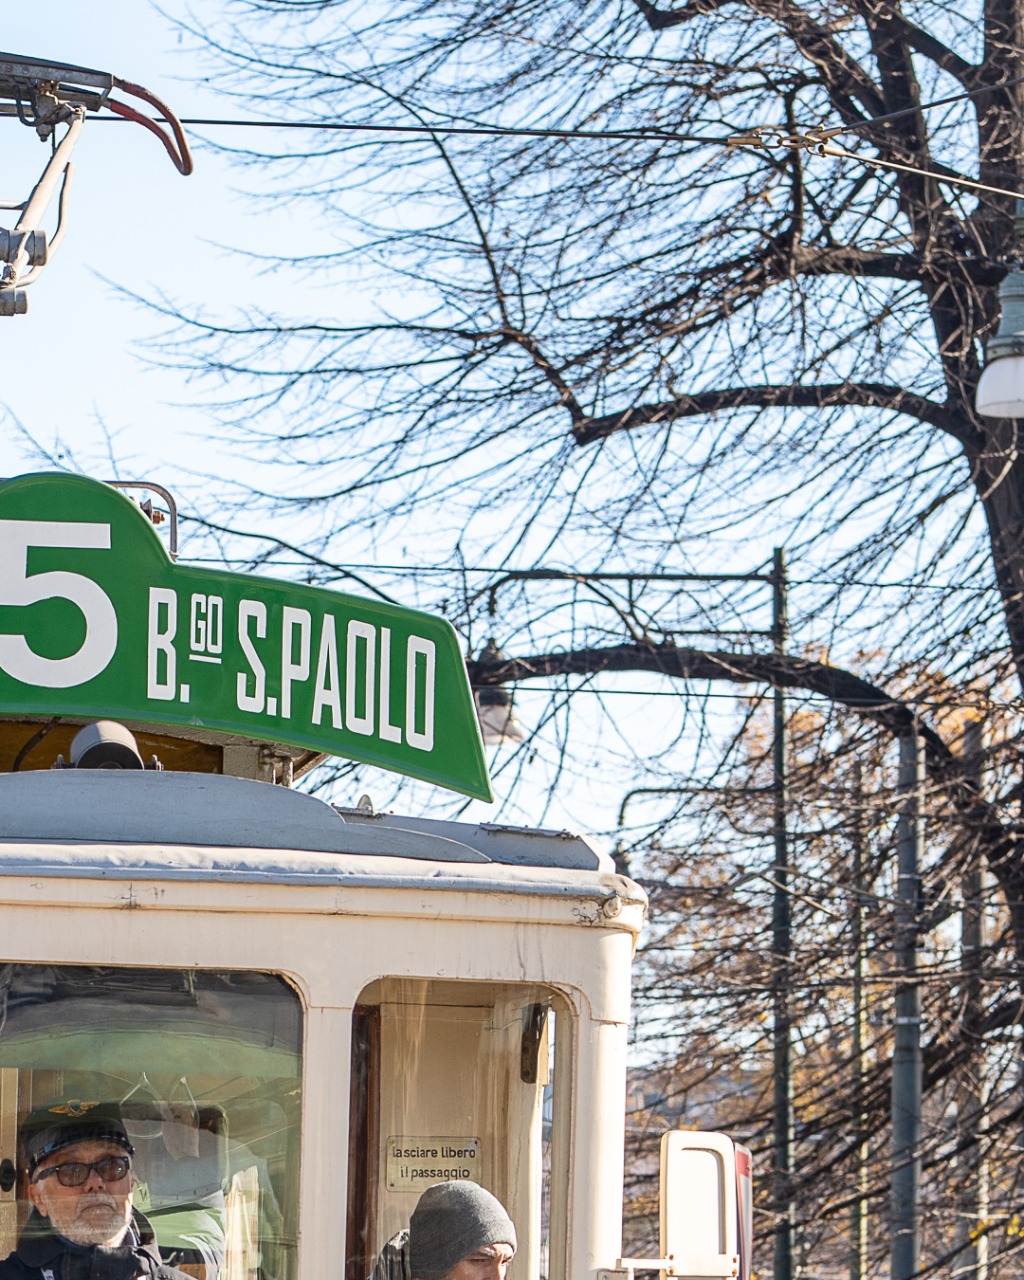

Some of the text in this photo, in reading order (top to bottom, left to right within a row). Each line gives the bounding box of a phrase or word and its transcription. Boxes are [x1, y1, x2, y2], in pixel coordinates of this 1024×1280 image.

[392, 1145, 477, 1159] lasciare libero
[400, 1165, 471, 1183] il passaggio
